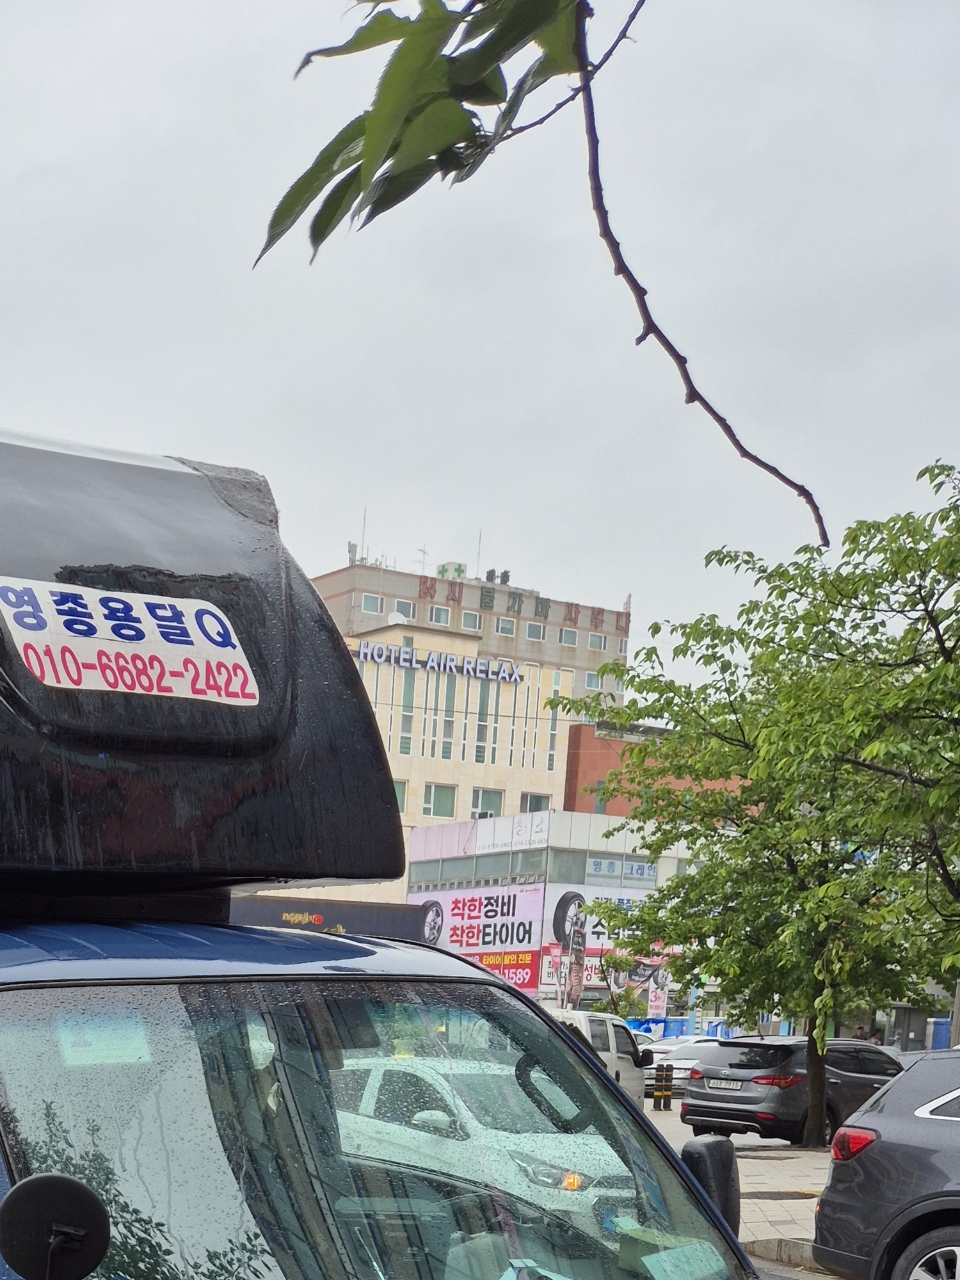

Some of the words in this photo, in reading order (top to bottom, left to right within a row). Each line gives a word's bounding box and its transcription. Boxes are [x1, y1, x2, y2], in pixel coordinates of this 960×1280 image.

[23, 642, 257, 700] 010-6682-2422
[359, 640, 422, 669] HOTEL
[426, 651, 458, 675] AIR
[462, 656, 523, 684] RELAX
[450, 893, 517, 921] 착한정비
[449, 921, 533, 948] 착한타이어
